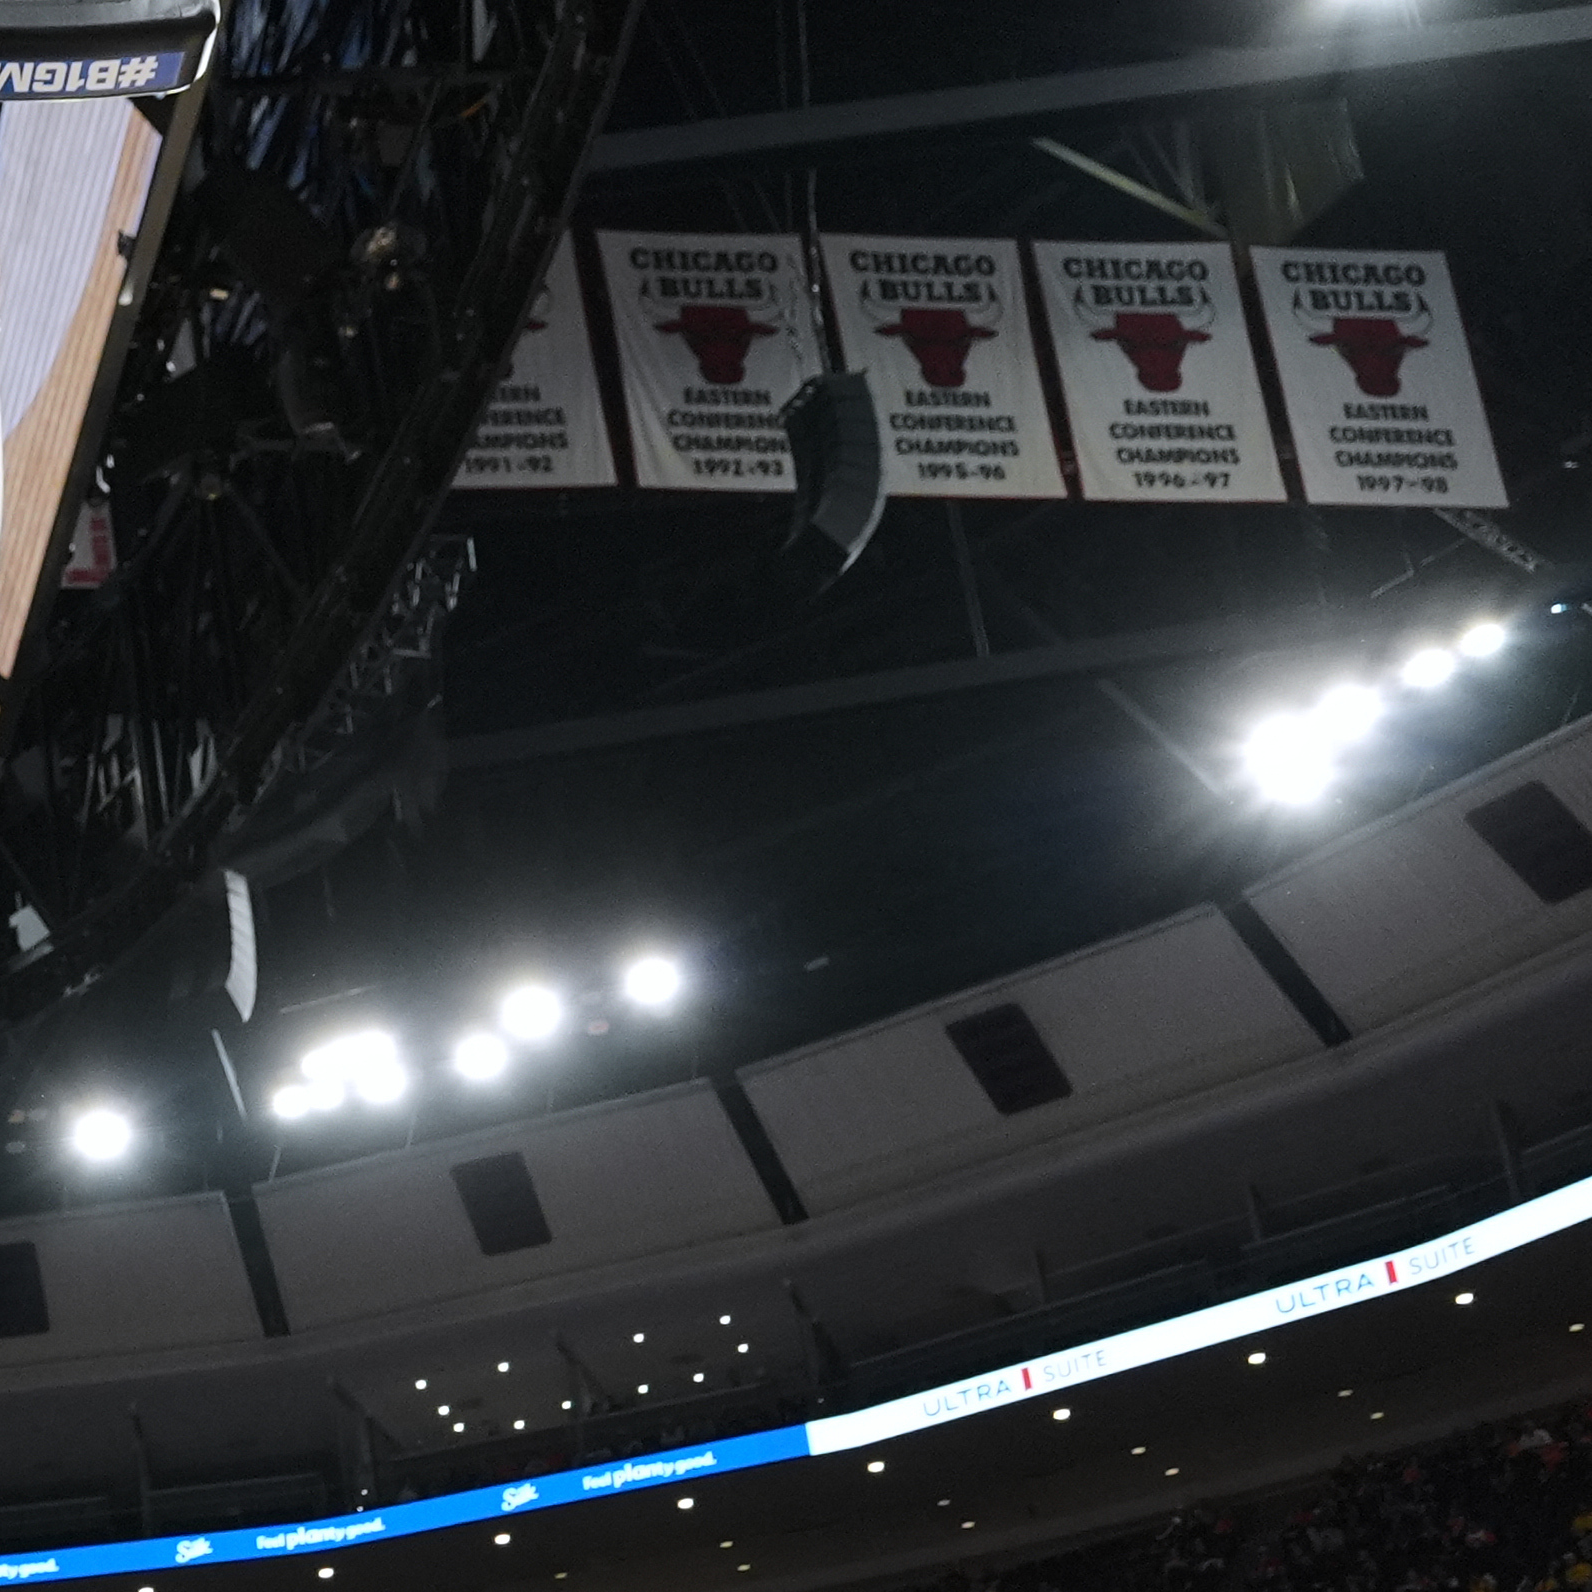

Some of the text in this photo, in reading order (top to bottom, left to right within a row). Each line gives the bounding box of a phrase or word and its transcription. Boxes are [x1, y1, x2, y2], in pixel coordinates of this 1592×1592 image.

[629, 248, 778, 273] CHICAGO
[849, 250, 996, 276] CHICAGO
[1063, 257, 1209, 282] CHICAGO
[1281, 262, 1425, 287] CHICAGO
[1092, 284, 1195, 307] BULLS
[1310, 289, 1412, 313] BULLS
[1276, 1236, 1477, 1315] ULTRA SUITE
[922, 1348, 1108, 1419] ULTRA SUITE
[612, 1461, 673, 1489] planty
[671, 1451, 717, 1475] good.
[500, 1480, 542, 1513] Silk
